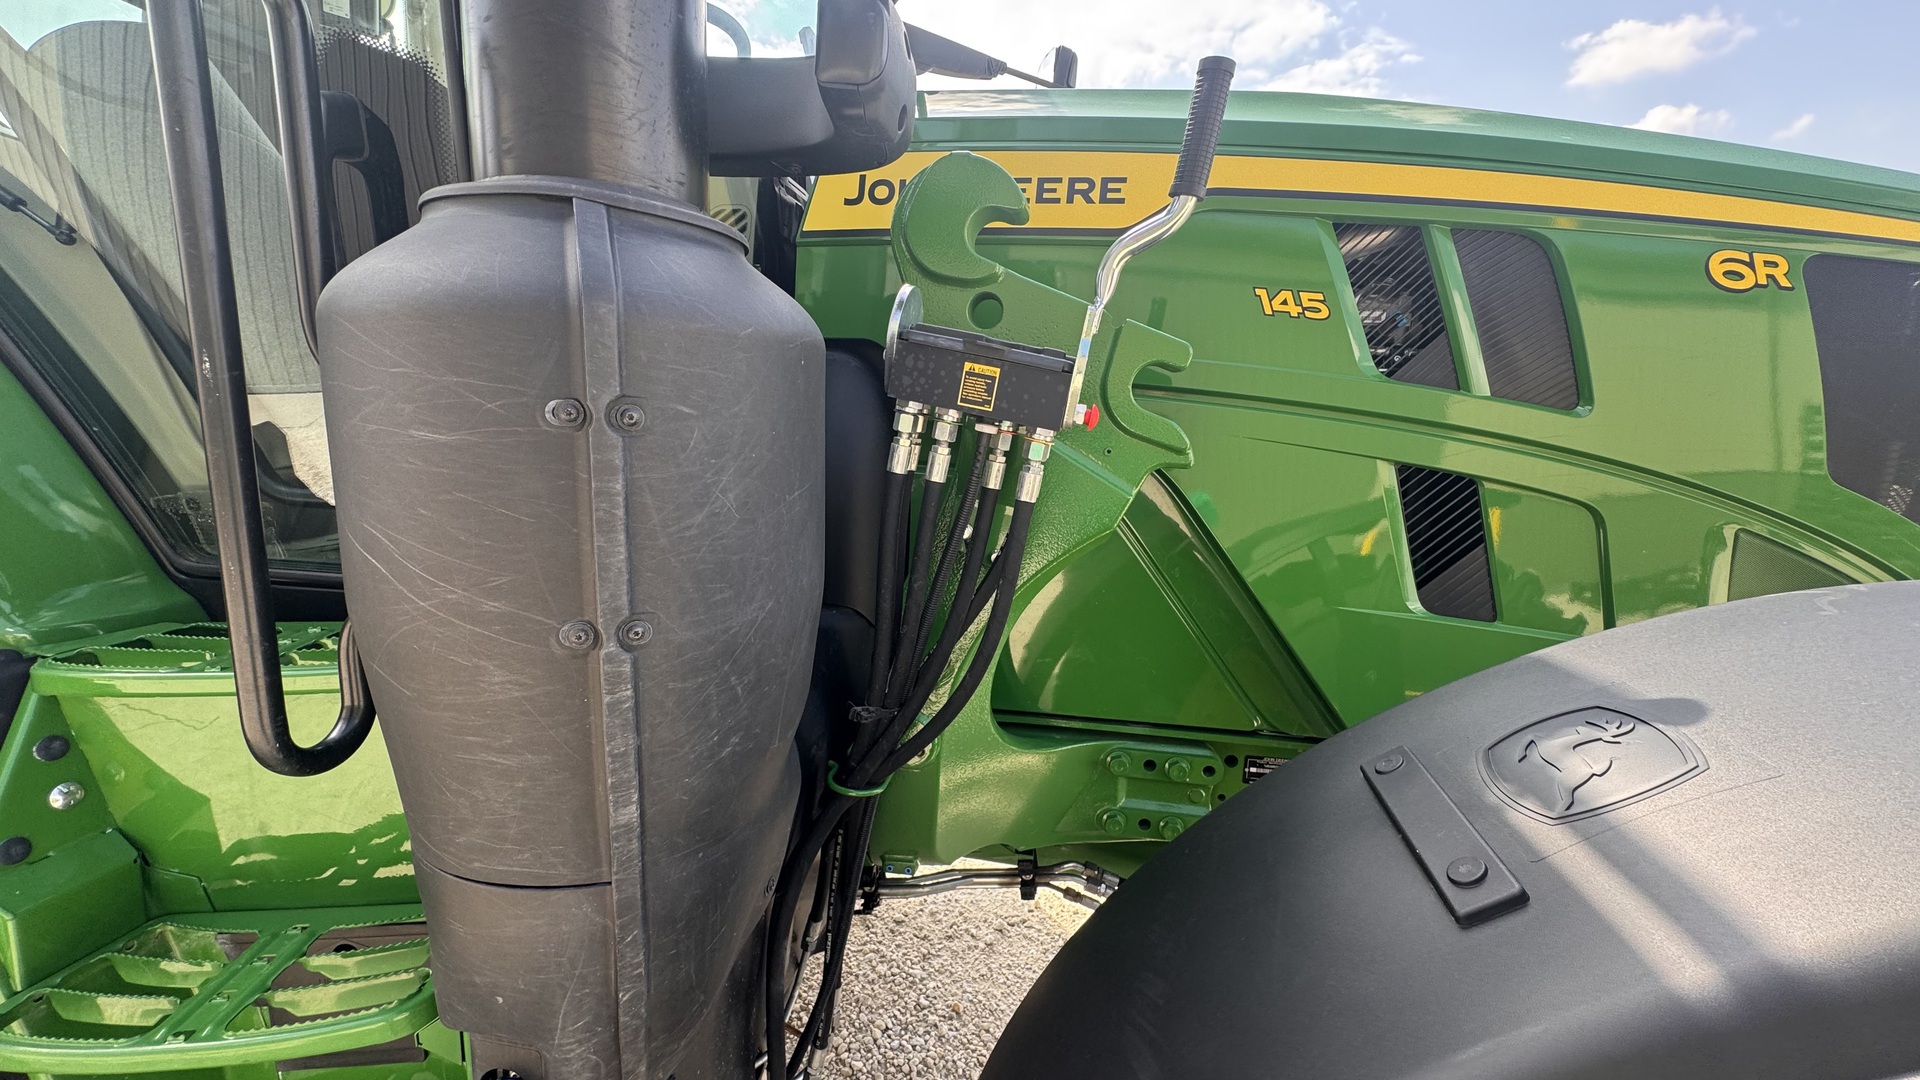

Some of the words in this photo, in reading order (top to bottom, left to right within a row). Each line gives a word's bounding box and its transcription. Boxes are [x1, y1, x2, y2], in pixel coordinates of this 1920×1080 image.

[844, 174, 907, 206] JO
[1705, 249, 1795, 293] 6R
[1253, 287, 1331, 321] 145
